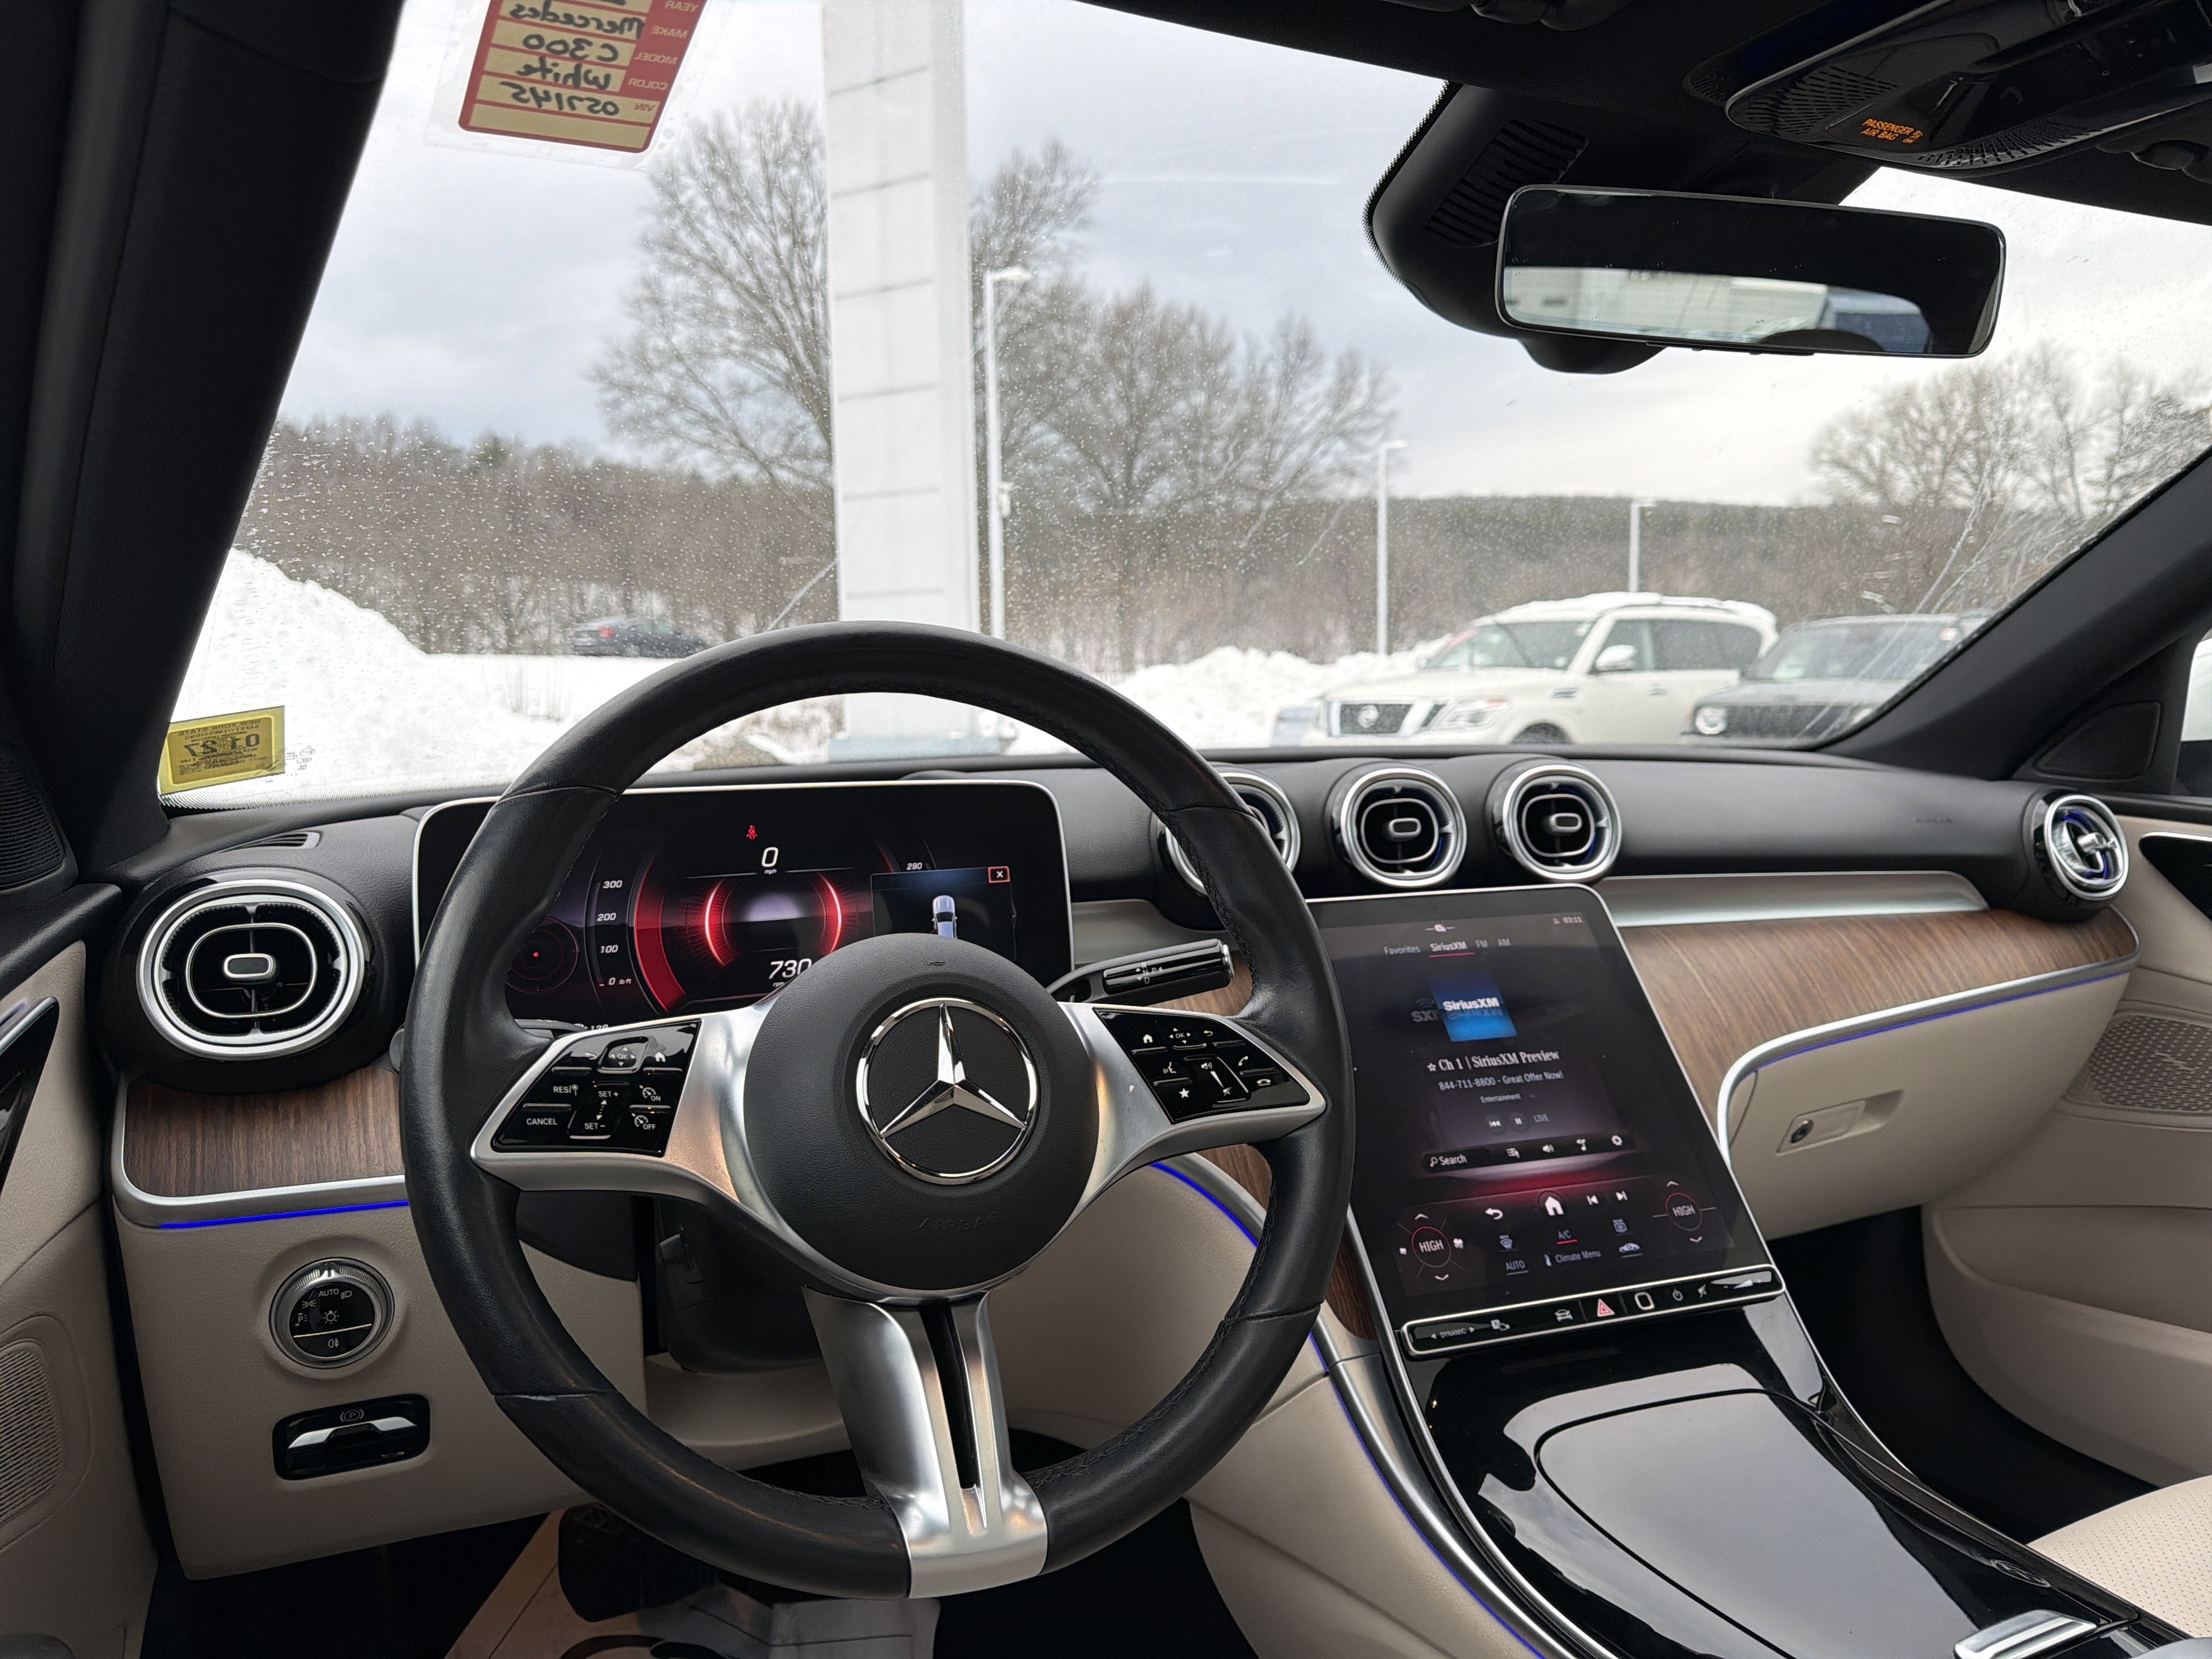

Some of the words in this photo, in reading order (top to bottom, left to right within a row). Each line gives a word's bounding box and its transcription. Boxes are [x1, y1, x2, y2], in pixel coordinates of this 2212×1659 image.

[1862, 119, 1914, 136] PASSENGER
[1861, 128, 1880, 137] AIR
[1877, 131, 1899, 140] BAG
[761, 847, 778, 867] 0
[603, 880, 623, 889] 300
[597, 912, 617, 921] 200
[600, 945, 619, 953] 100
[1384, 945, 1421, 956] Favorites
[1430, 940, 1467, 952] SiriusXM
[1476, 940, 1488, 949] FM
[1498, 938, 1511, 946] AM
[768, 958, 812, 980] 730
[1443, 997, 1500, 1011] SiriusXM
[1438, 1058, 1454, 1071] Ch
[1457, 1057, 1464, 1069] 1
[1472, 1051, 1519, 1068] SiriusXM
[1520, 1049, 1560, 1063] Preview
[1502, 1074, 1523, 1085] Great
[1523, 1071, 1543, 1082] Offer
[526, 1118, 557, 1126] CANCEL
[1533, 1113, 1549, 1123] LIVE
[1439, 1154, 1468, 1166] Search
[1672, 1204, 1696, 1217] HIGH
[1419, 1239, 1444, 1252] HIGH
[1555, 1252, 1582, 1263] Climate
[1581, 1250, 1602, 1260] Menu
[1505, 1260, 1526, 1271] AUTO
[318, 1289, 340, 1297] AUTO
[1440, 1327, 1467, 1339] DYNAMIC
